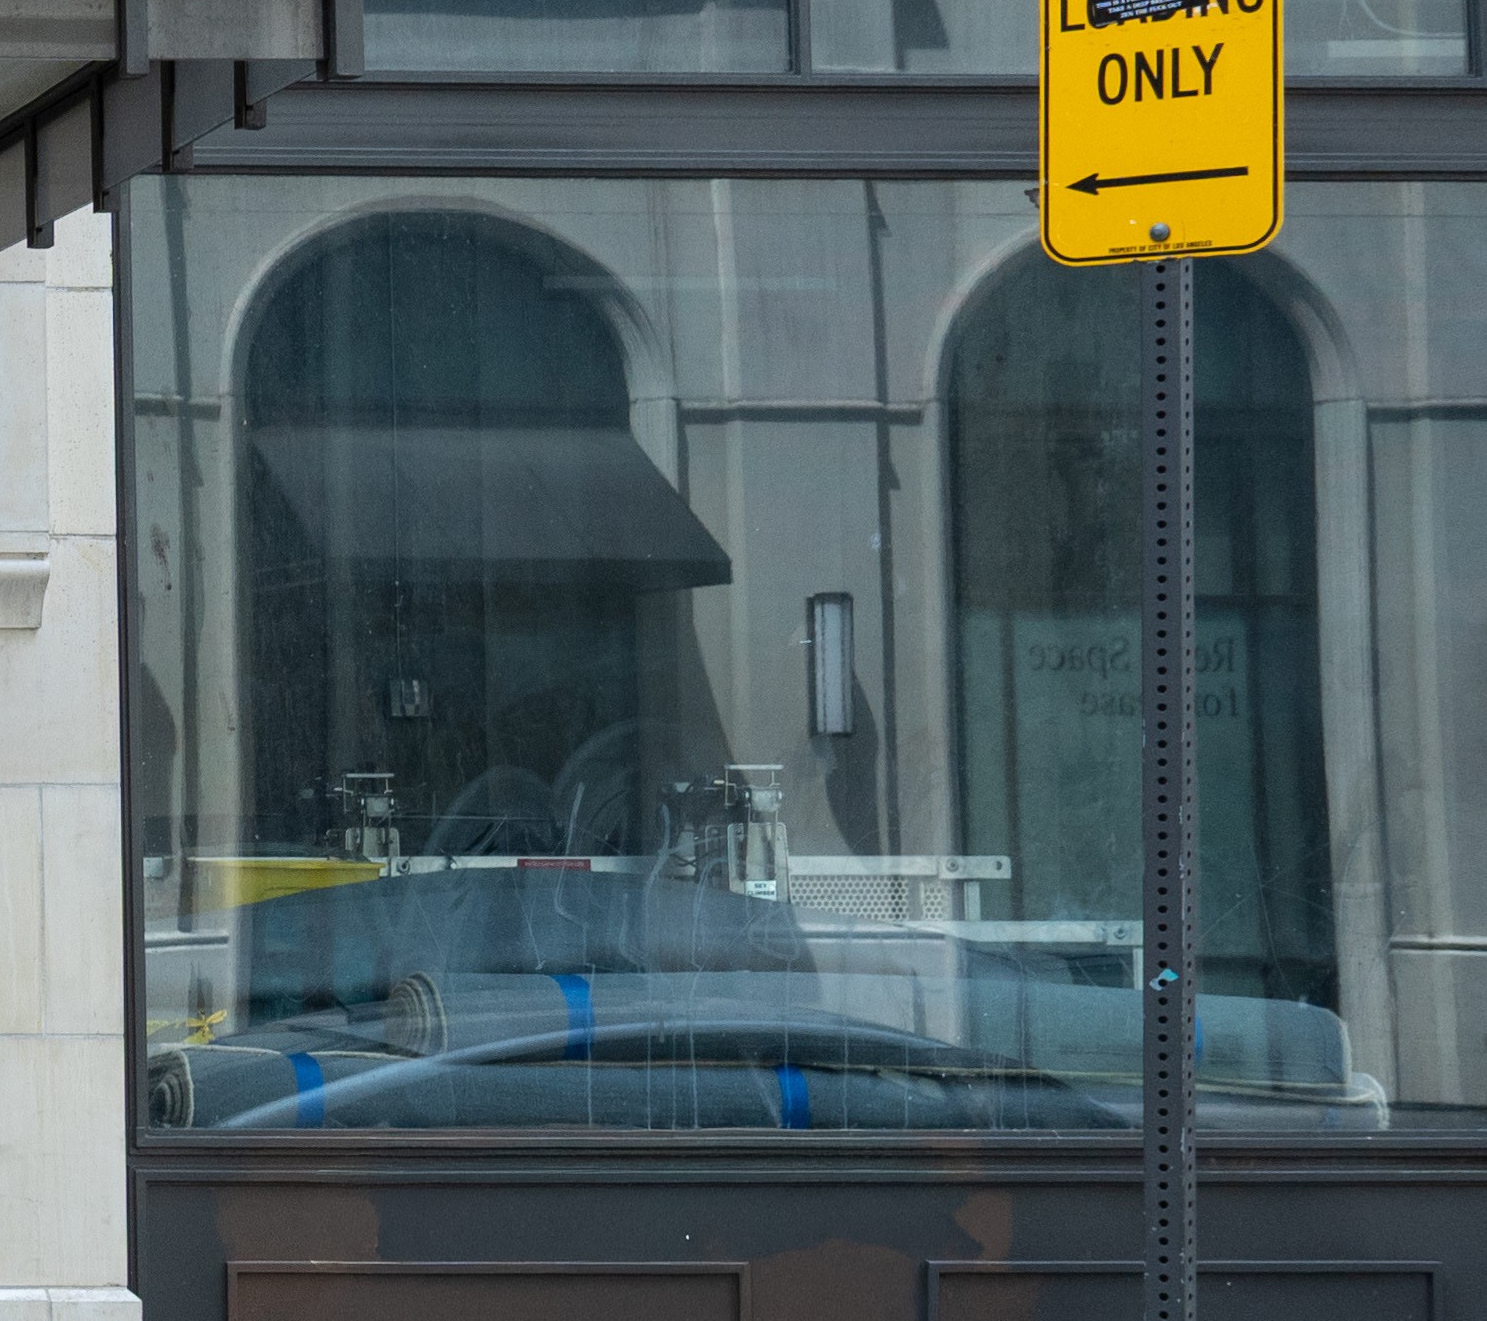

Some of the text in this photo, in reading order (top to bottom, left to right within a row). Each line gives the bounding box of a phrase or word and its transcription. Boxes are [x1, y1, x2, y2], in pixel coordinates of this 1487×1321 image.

[1108, 6, 1125, 14] TAKE
[1132, 0, 1150, 9] DEEP
[1135, 8, 1148, 16] THE
[1149, 5, 1167, 14] FUCK
[1098, 42, 1225, 106] ONLY
[1109, 246, 1137, 254] PROPERTY
[1148, 244, 1161, 252] CITY
